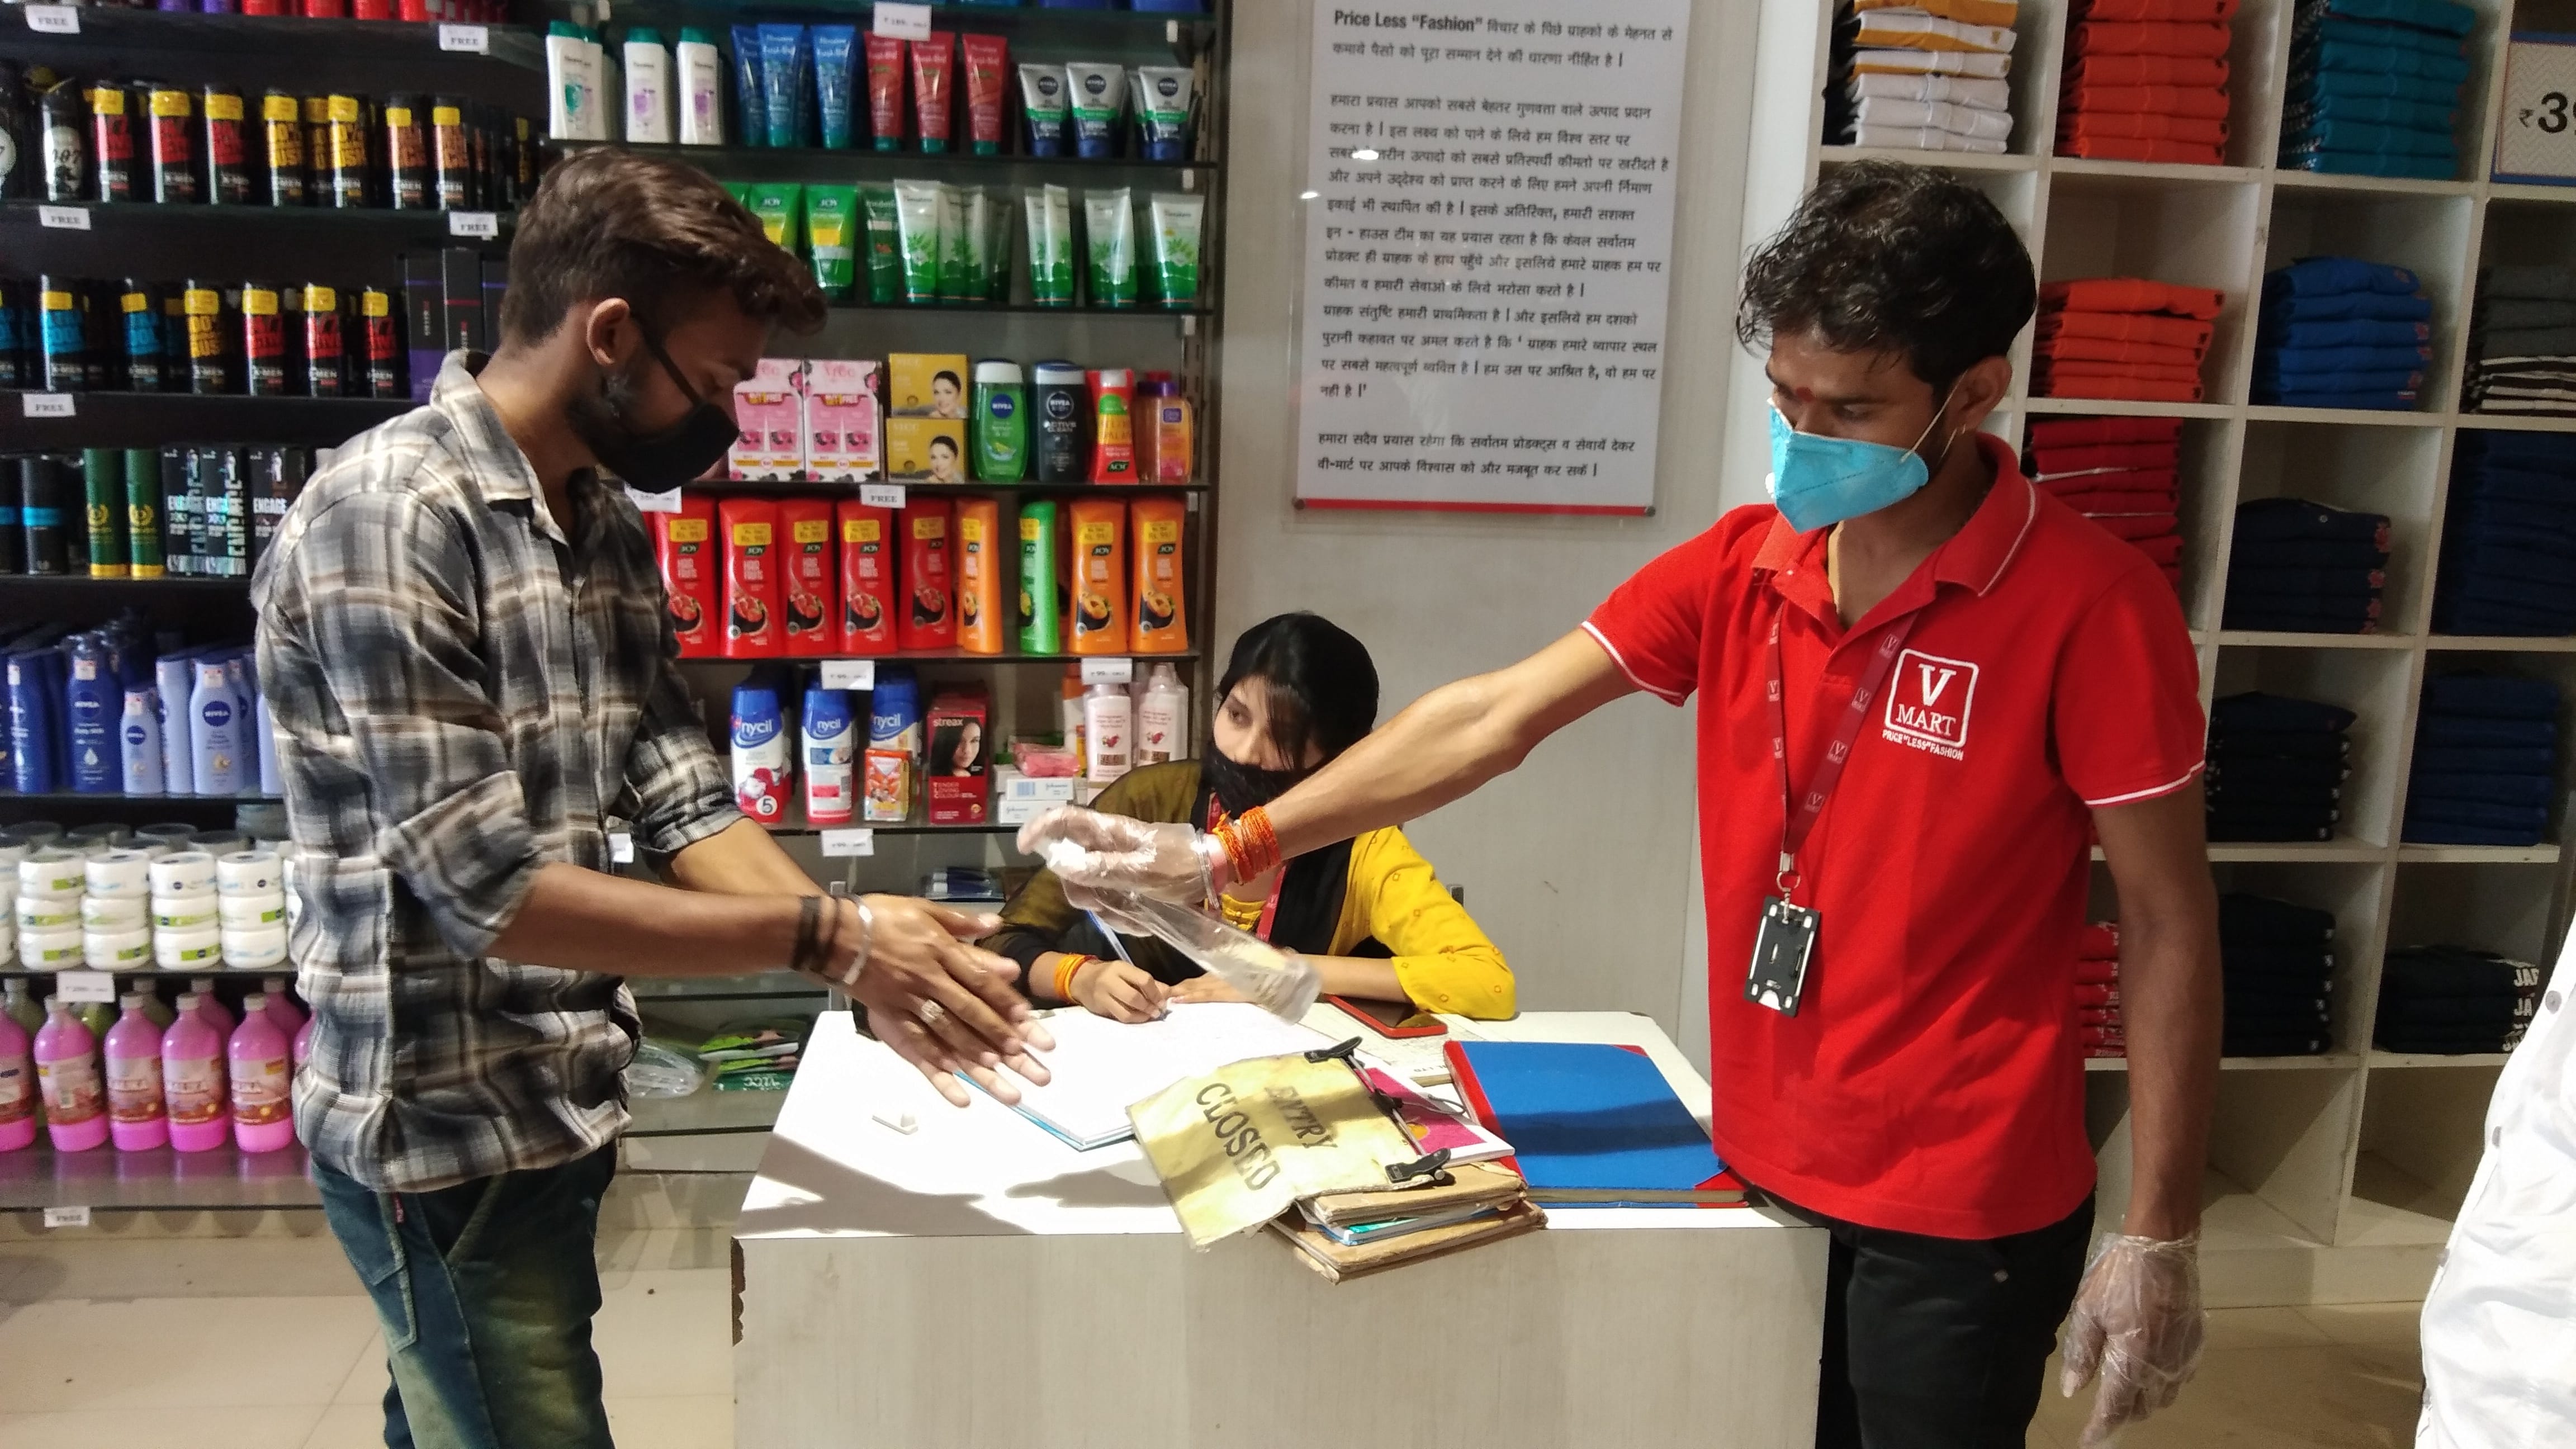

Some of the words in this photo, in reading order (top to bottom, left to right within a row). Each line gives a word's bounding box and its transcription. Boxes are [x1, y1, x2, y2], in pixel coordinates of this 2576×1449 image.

[1334, 9, 1371, 27] Price
[1375, 12, 1407, 29] Less
[1412, 13, 1483, 32] "Fashion"
[2519, 92, 2576, 134] ₹3
[1918, 663, 1957, 707] V
[741, 719, 773, 736] nycil
[817, 718, 841, 732] nycil
[873, 713, 901, 728] nycil
[933, 717, 963, 727] streax
[1895, 703, 1957, 737] MART
[762, 798, 773, 812] 5
[1196, 1082, 1281, 1191] CLOSED
